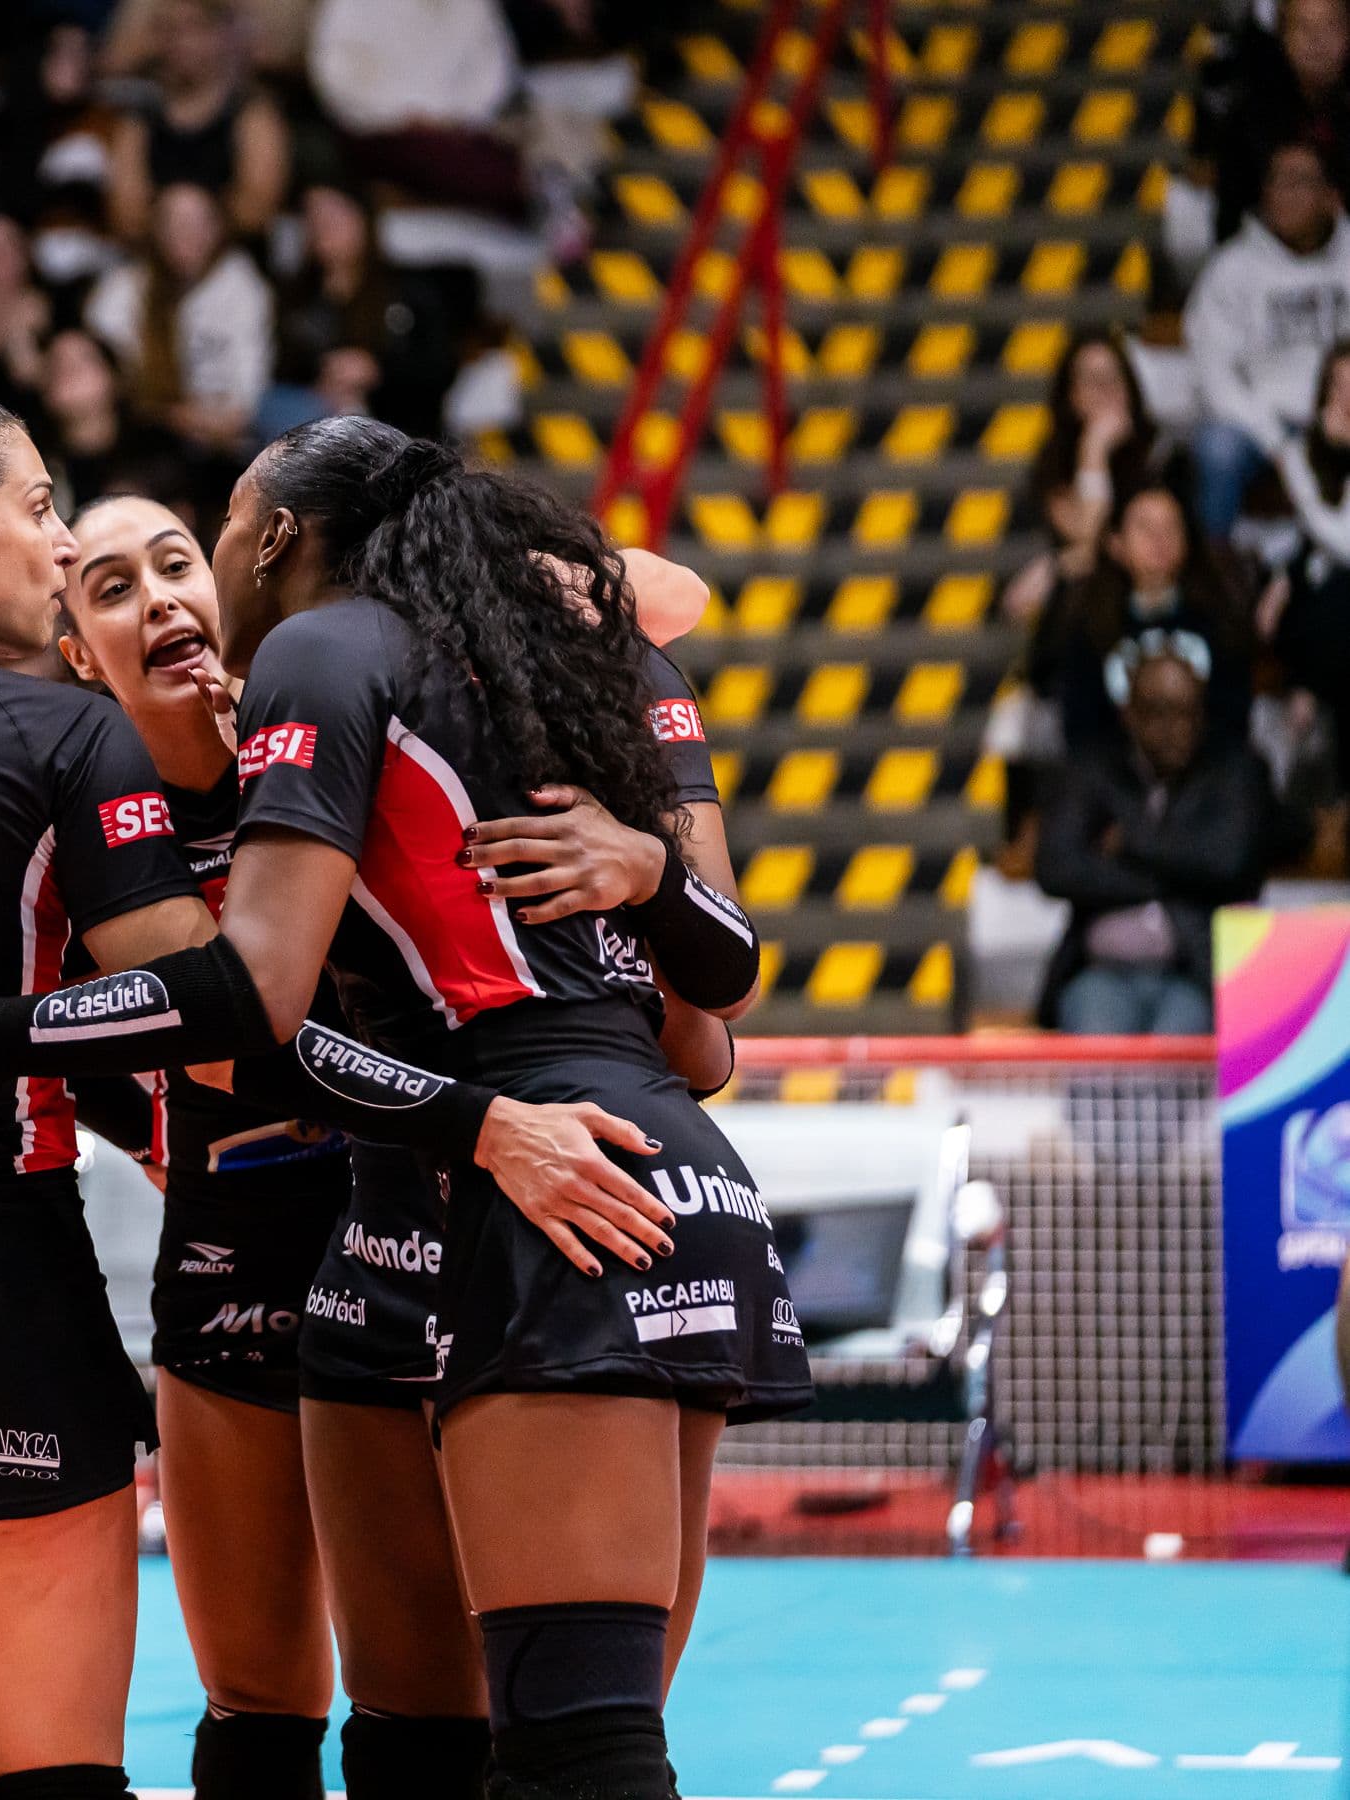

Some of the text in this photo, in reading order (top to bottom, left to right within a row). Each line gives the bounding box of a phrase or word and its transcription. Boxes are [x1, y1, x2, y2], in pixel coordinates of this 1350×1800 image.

[649, 703, 699, 740] ESI
[189, 850, 234, 872] ENAL
[49, 976, 154, 1022] Plasútil
[651, 1165, 773, 1231] Unime
[341, 1222, 443, 1274] Monde
[178, 1260, 235, 1274] PENALTY
[625, 1279, 736, 1314] PACAEMBU
